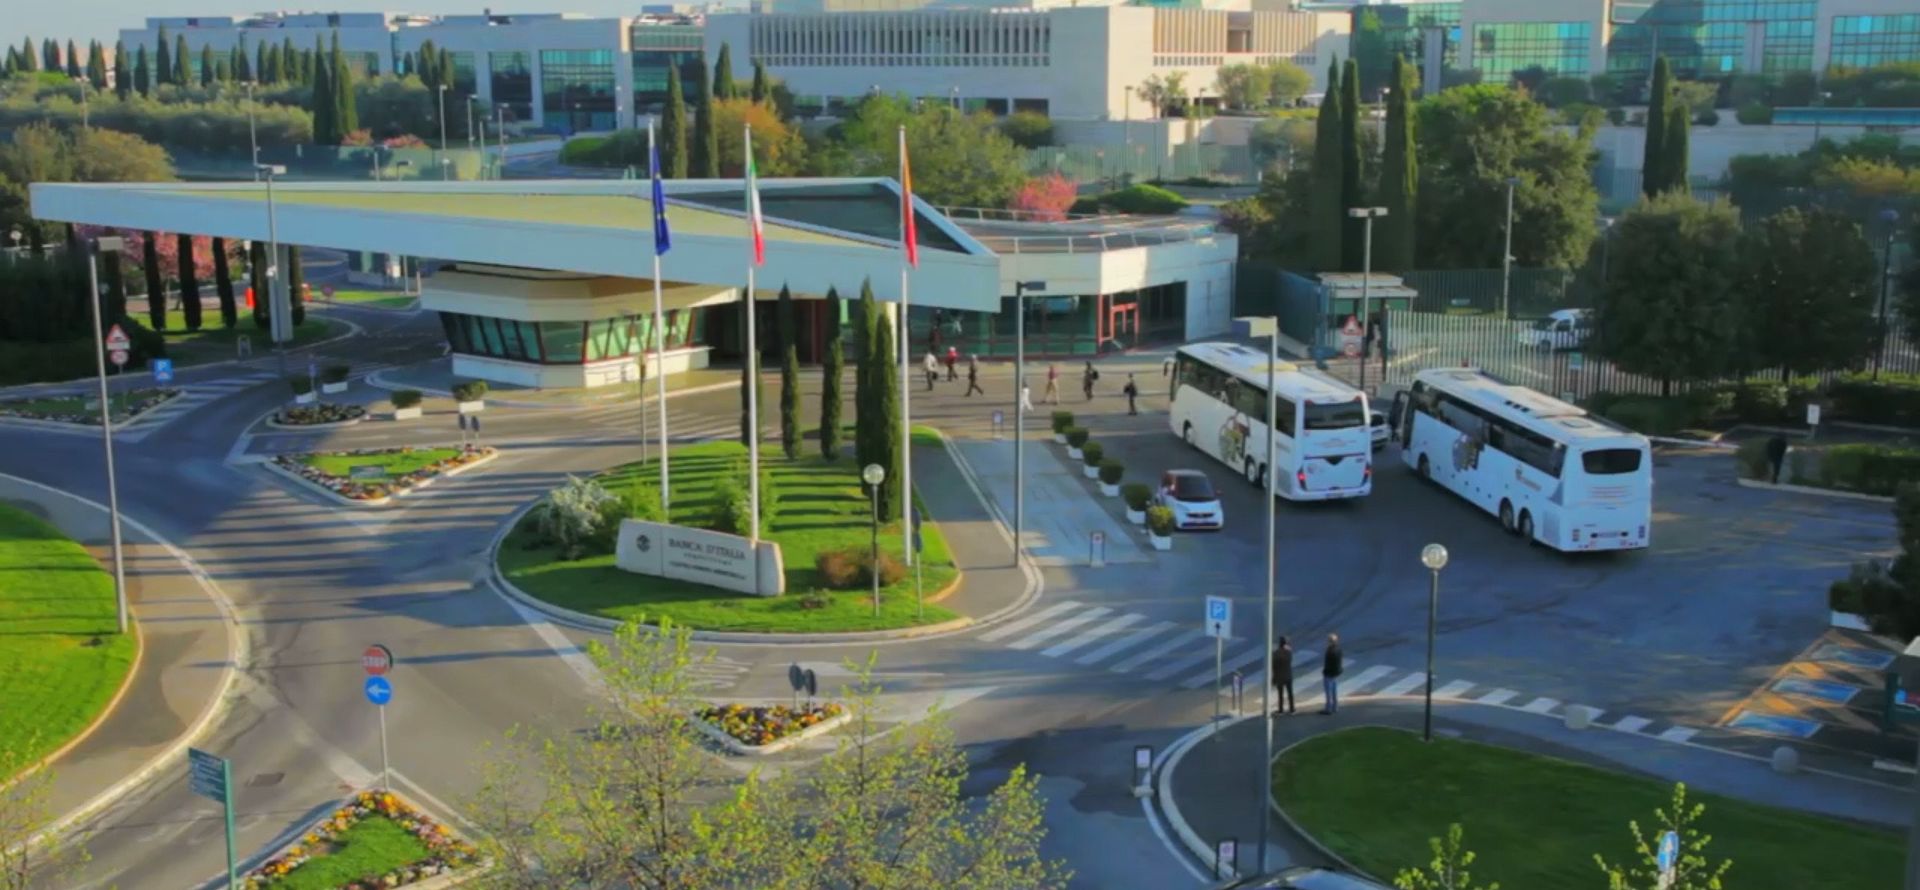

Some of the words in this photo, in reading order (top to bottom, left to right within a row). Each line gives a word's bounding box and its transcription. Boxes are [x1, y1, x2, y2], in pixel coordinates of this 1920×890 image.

[668, 538, 703, 552] BANCA
[705, 544, 746, 560] D'ITALIA
[1213, 601, 1224, 618] P
